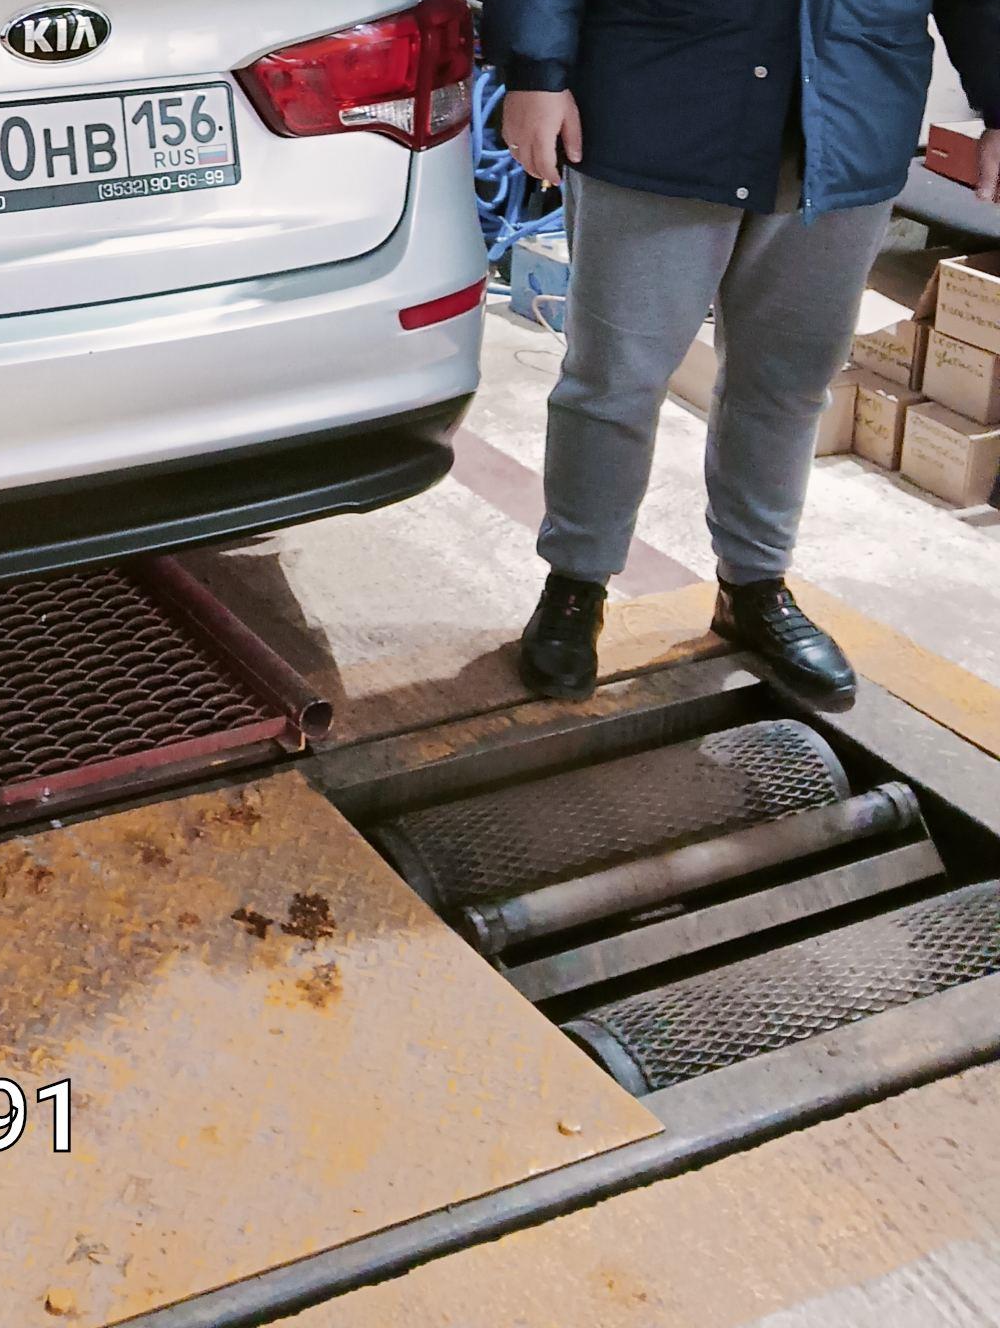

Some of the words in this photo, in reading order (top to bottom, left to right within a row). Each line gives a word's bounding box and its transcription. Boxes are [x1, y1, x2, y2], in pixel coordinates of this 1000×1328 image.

[22, 14, 98, 53] KIA
[131, 95, 216, 149] 156
[153, 148, 196, 169] RUS
